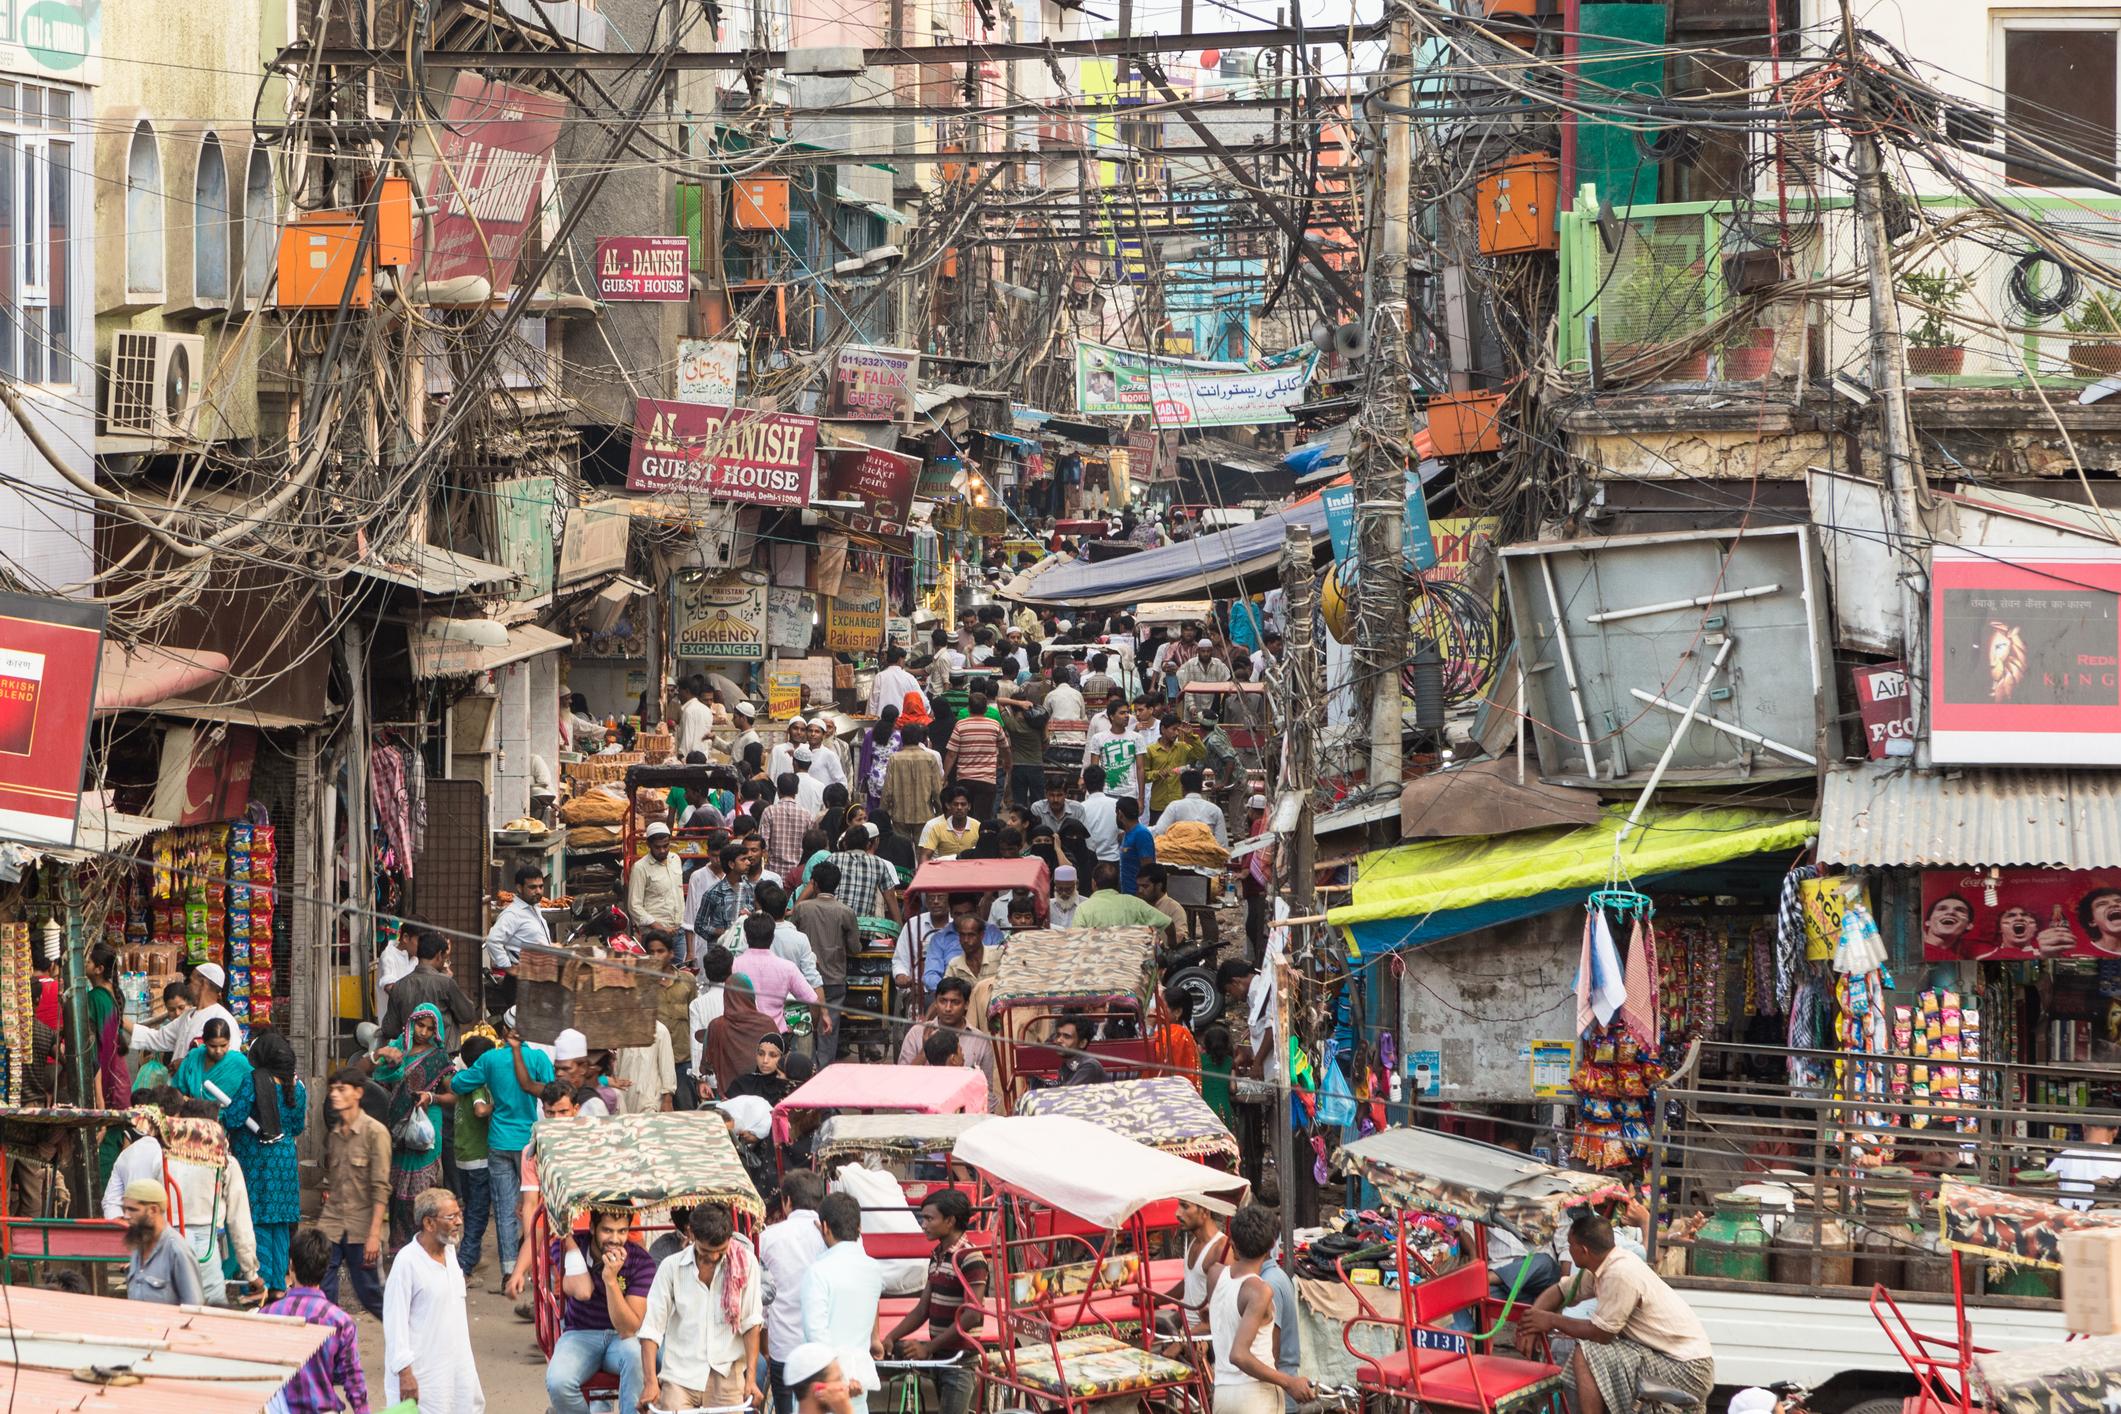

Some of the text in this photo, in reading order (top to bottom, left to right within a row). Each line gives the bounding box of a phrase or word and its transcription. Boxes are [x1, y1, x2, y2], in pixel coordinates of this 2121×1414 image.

[602, 248, 621, 275] AL
[632, 249, 684, 276] DANISH
[602, 279, 685, 293] GUEST HOUSE
[847, 390, 895, 409] GUEST
[645, 411, 678, 452] AL
[702, 416, 804, 466] DANISH
[641, 456, 800, 492] GUEST HOUSE
[859, 476, 889, 489] point
[832, 599, 881, 614] CURRENCY
[832, 615, 881, 628] EXCHANGER
[681, 629, 759, 643] CURRENCY
[681, 644, 760, 656] EXCHANGER
[2043, 672, 2115, 687] KING
